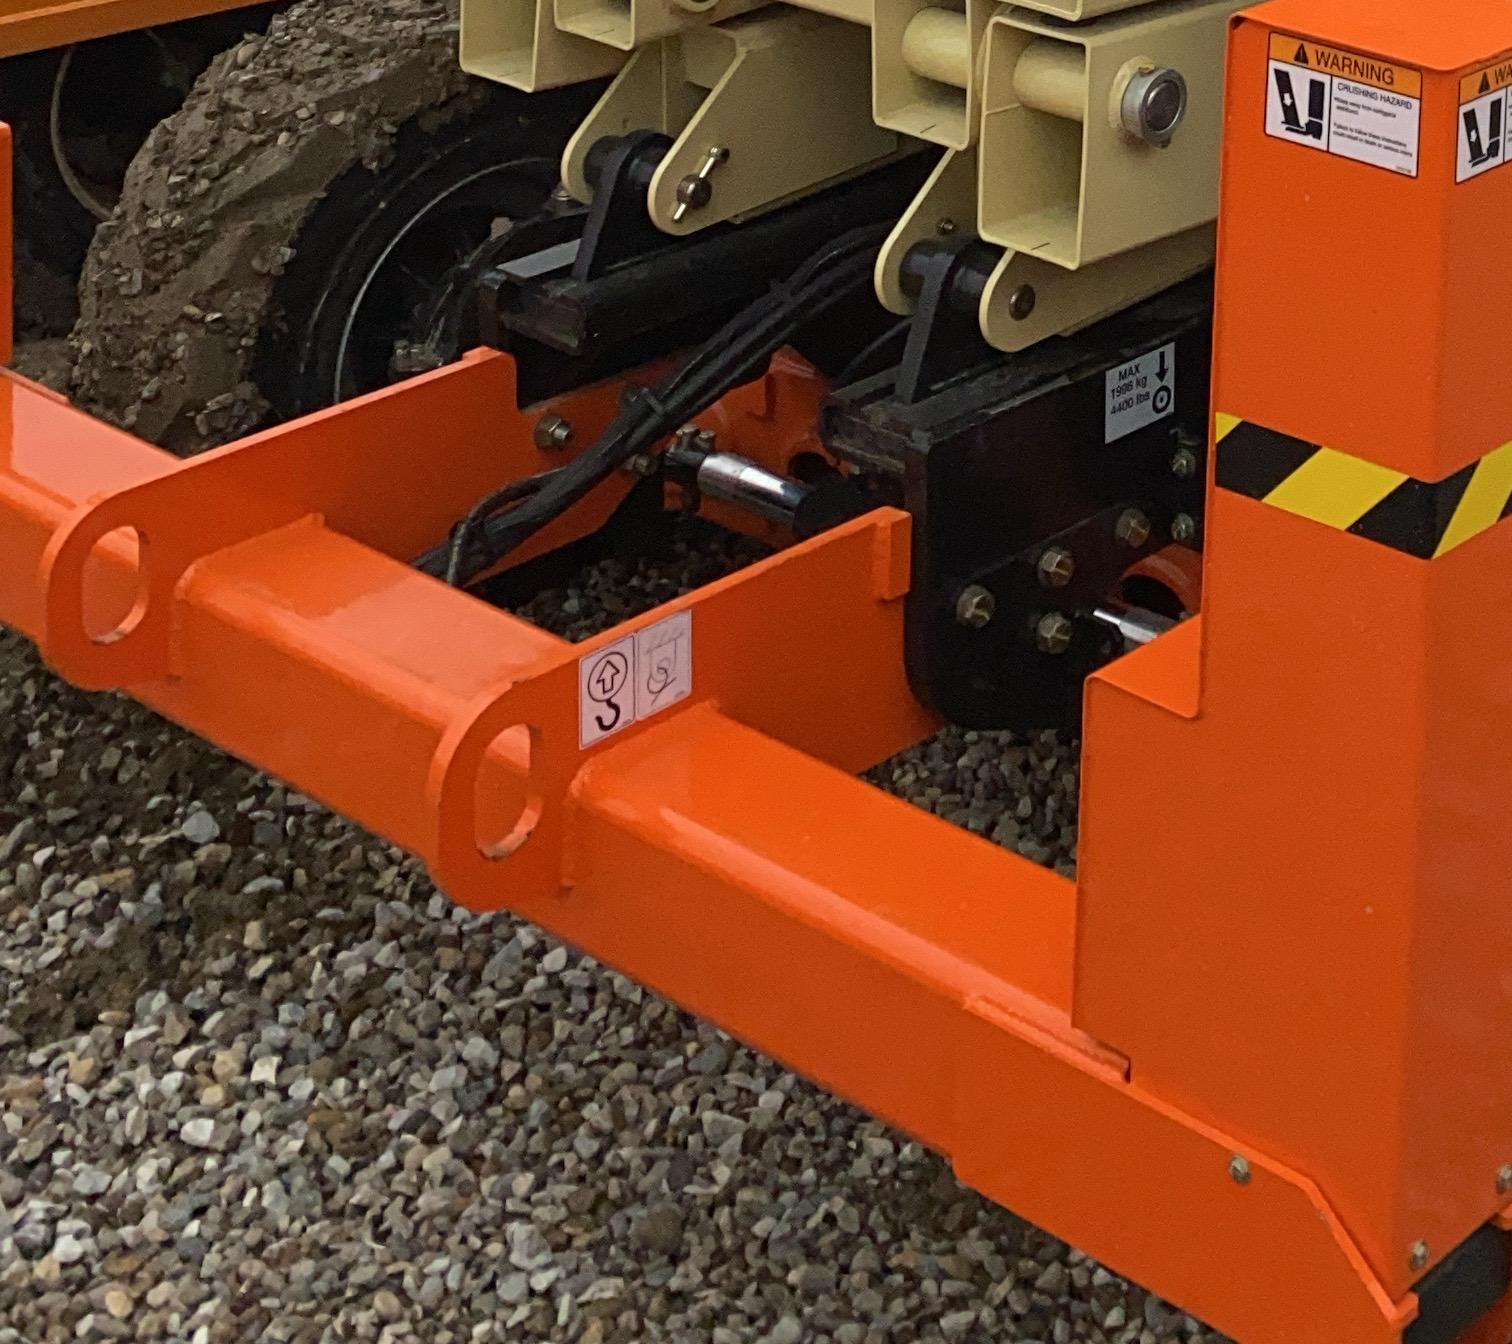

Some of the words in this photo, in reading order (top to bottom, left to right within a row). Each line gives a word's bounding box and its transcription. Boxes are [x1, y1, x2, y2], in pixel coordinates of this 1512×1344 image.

[1315, 48, 1395, 86] WARNING
[1379, 91, 1412, 110] HAZARD
[1118, 363, 1140, 382] MAX
[1110, 397, 1134, 415] 4400
